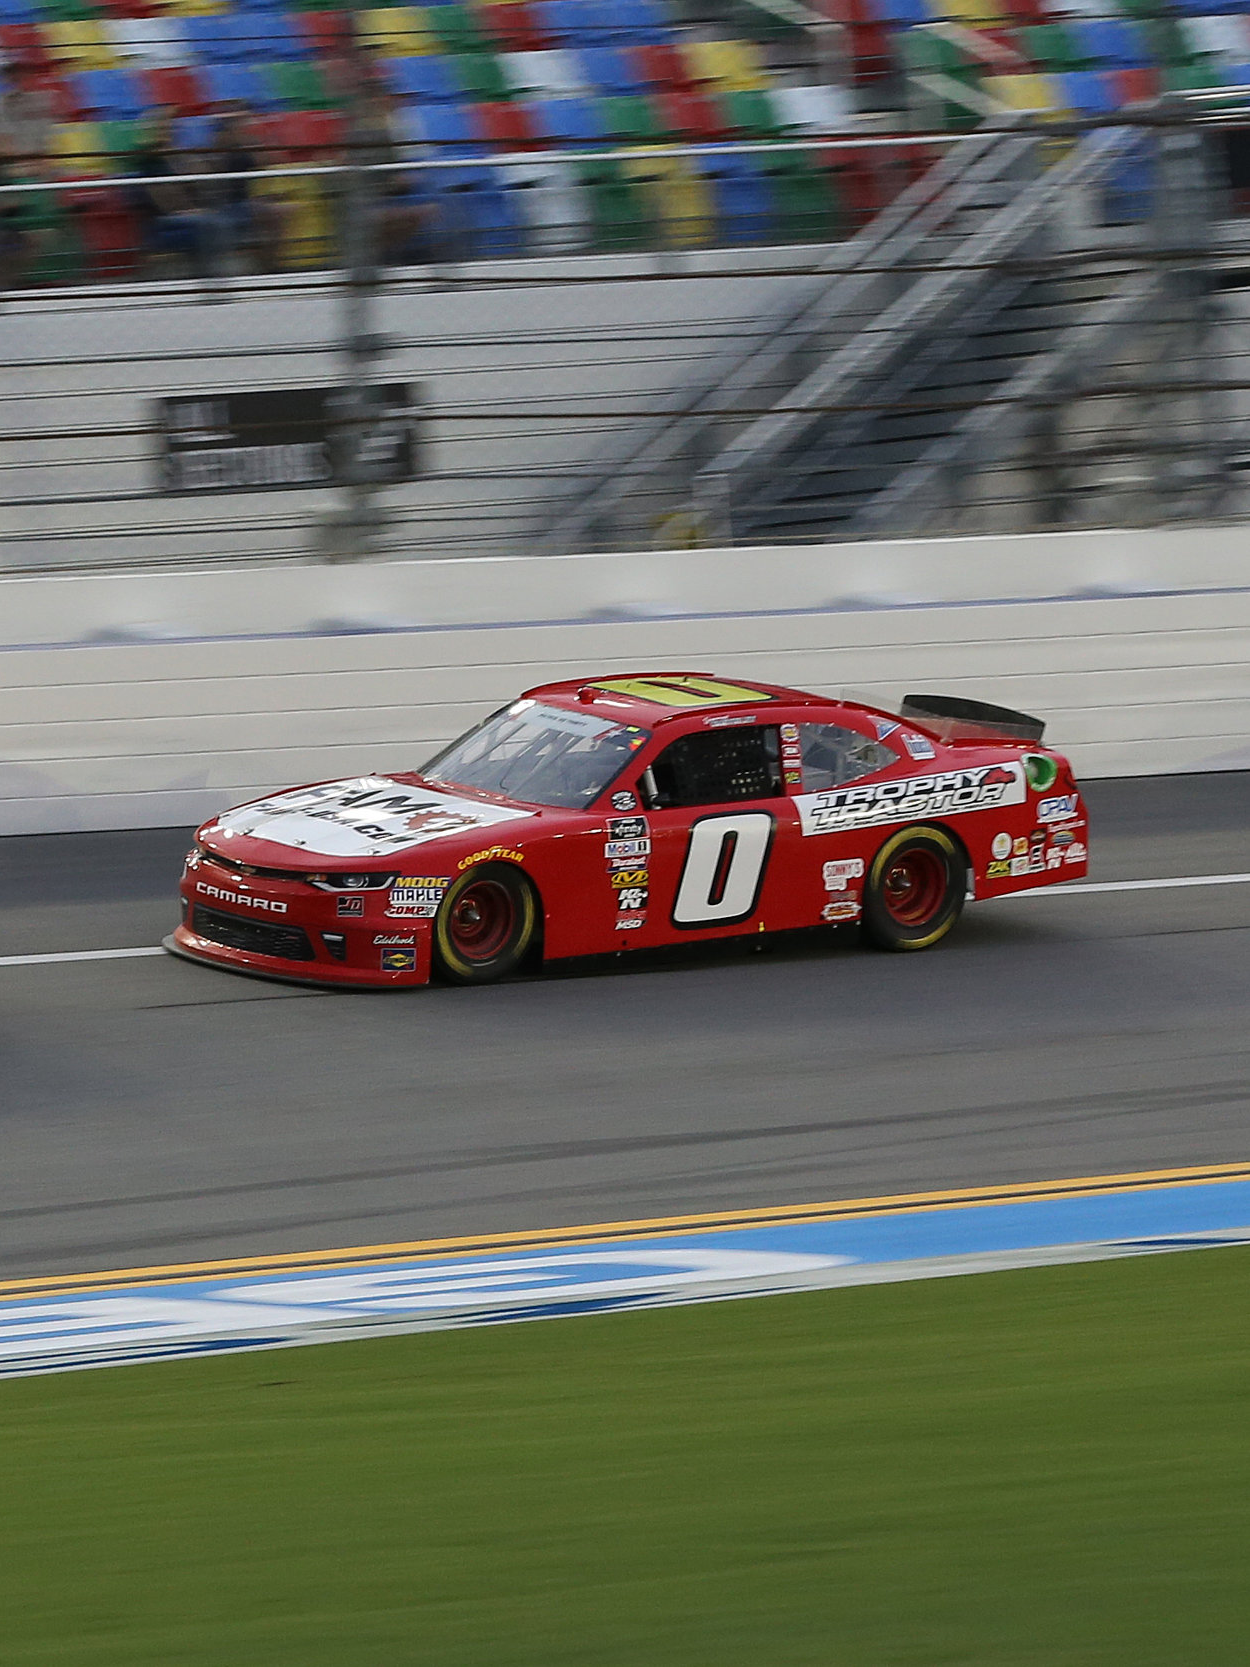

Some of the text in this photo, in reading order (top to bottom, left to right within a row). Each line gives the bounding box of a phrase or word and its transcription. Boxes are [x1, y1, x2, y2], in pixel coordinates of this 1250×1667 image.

[816, 767, 991, 808] TROPHY
[811, 782, 1007, 827] TRACTOR
[457, 845, 525, 871] GOODYEAR
[670, 810, 775, 929] 0
[196, 881, 288, 913] CAMARO
[391, 889, 442, 901] MAHLE
[394, 876, 451, 888] MOOG
